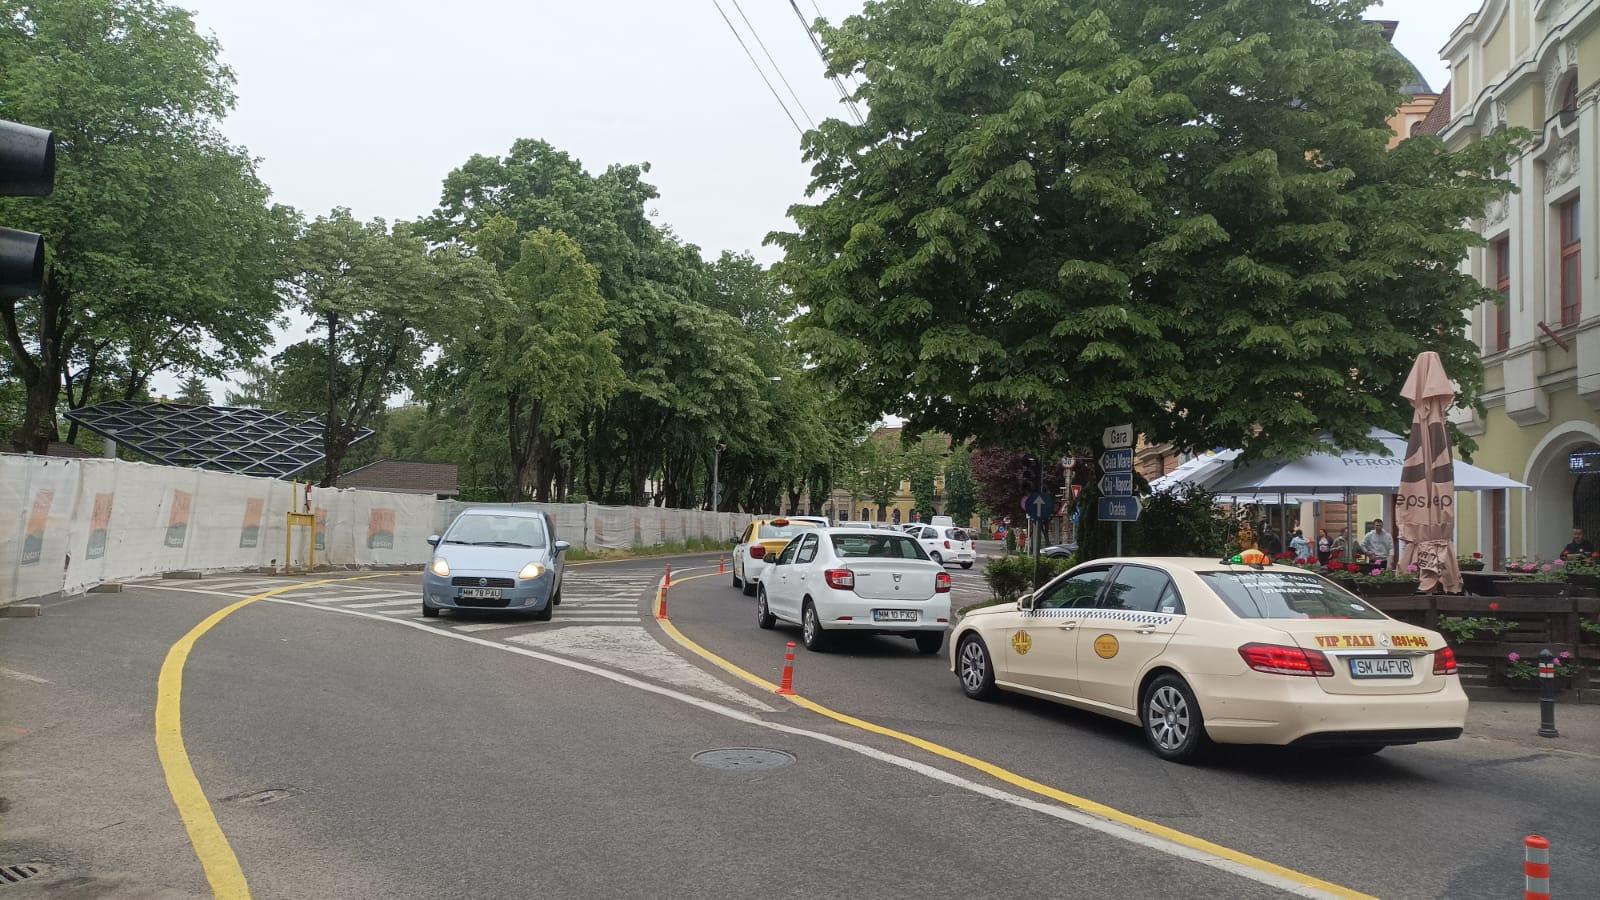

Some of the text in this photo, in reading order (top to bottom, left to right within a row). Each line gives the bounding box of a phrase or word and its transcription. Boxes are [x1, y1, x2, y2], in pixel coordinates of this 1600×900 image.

[1111, 430, 1127, 443] Gara
[1104, 453, 1132, 469] Baia Mare
[1341, 457, 1404, 466] PERON
[1109, 501, 1126, 515] Oradea
[1314, 635, 1340, 647] VIP
[1342, 635, 1376, 648] TAXI
[1357, 660, 1373, 675] SM
